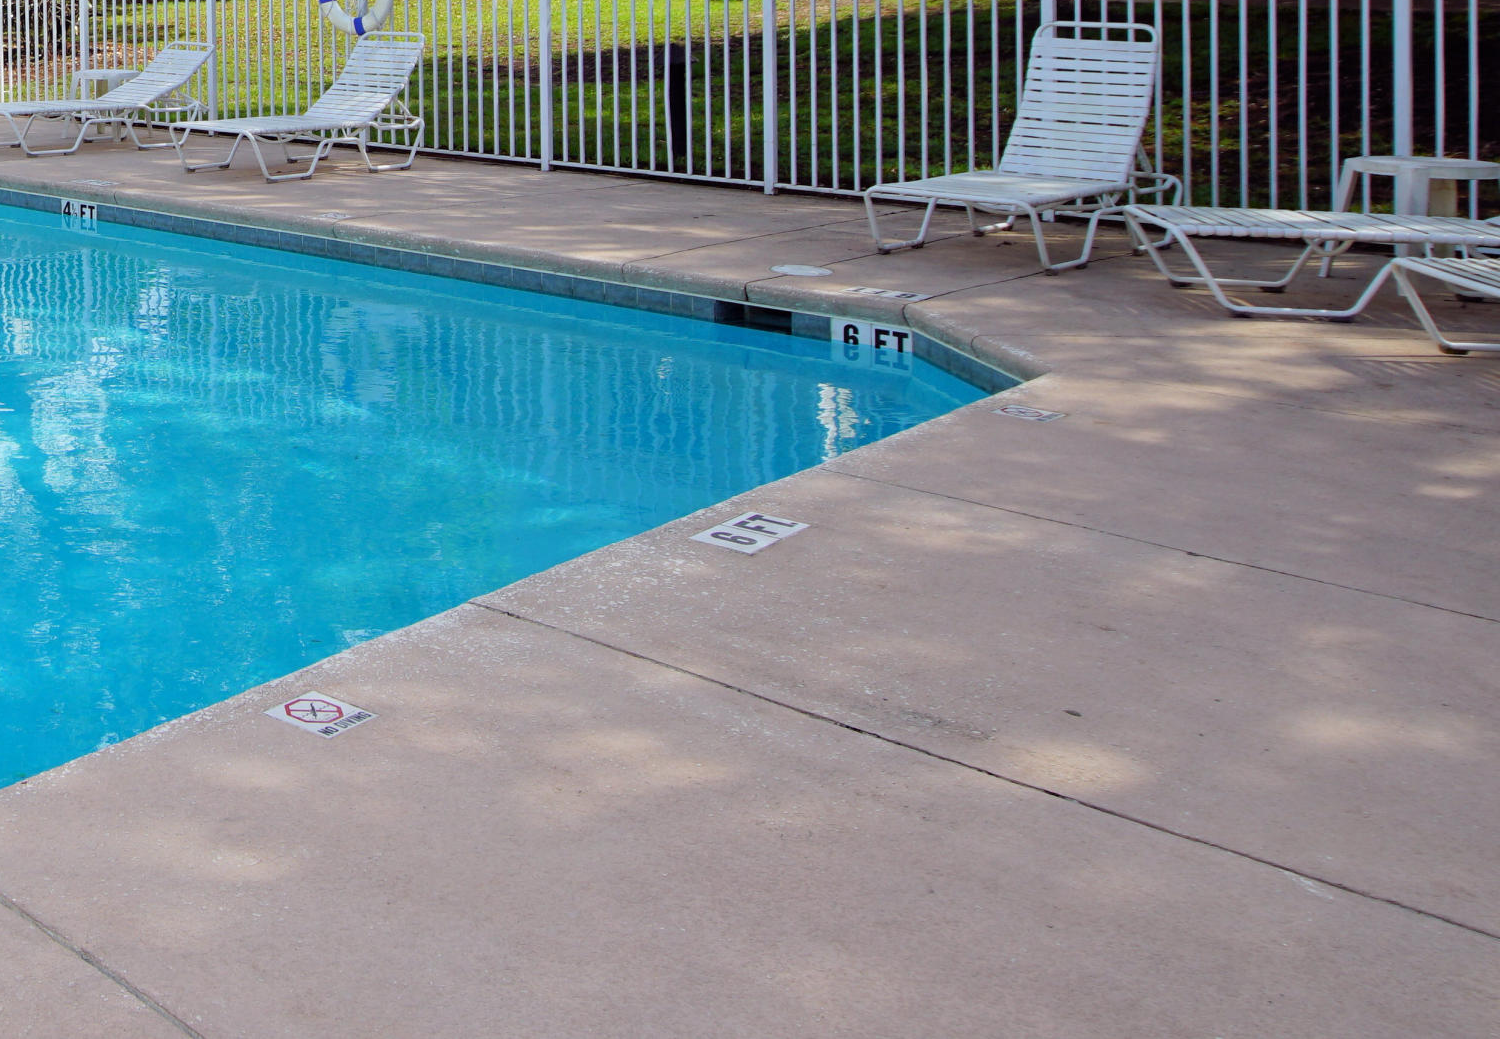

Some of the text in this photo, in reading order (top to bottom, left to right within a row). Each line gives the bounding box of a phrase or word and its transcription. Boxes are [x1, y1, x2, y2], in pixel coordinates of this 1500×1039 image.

[80, 204, 95, 219] FT
[843, 323, 909, 353] 6 FT
[710, 531, 758, 546] 6
[317, 711, 373, 736] NO DIVING
